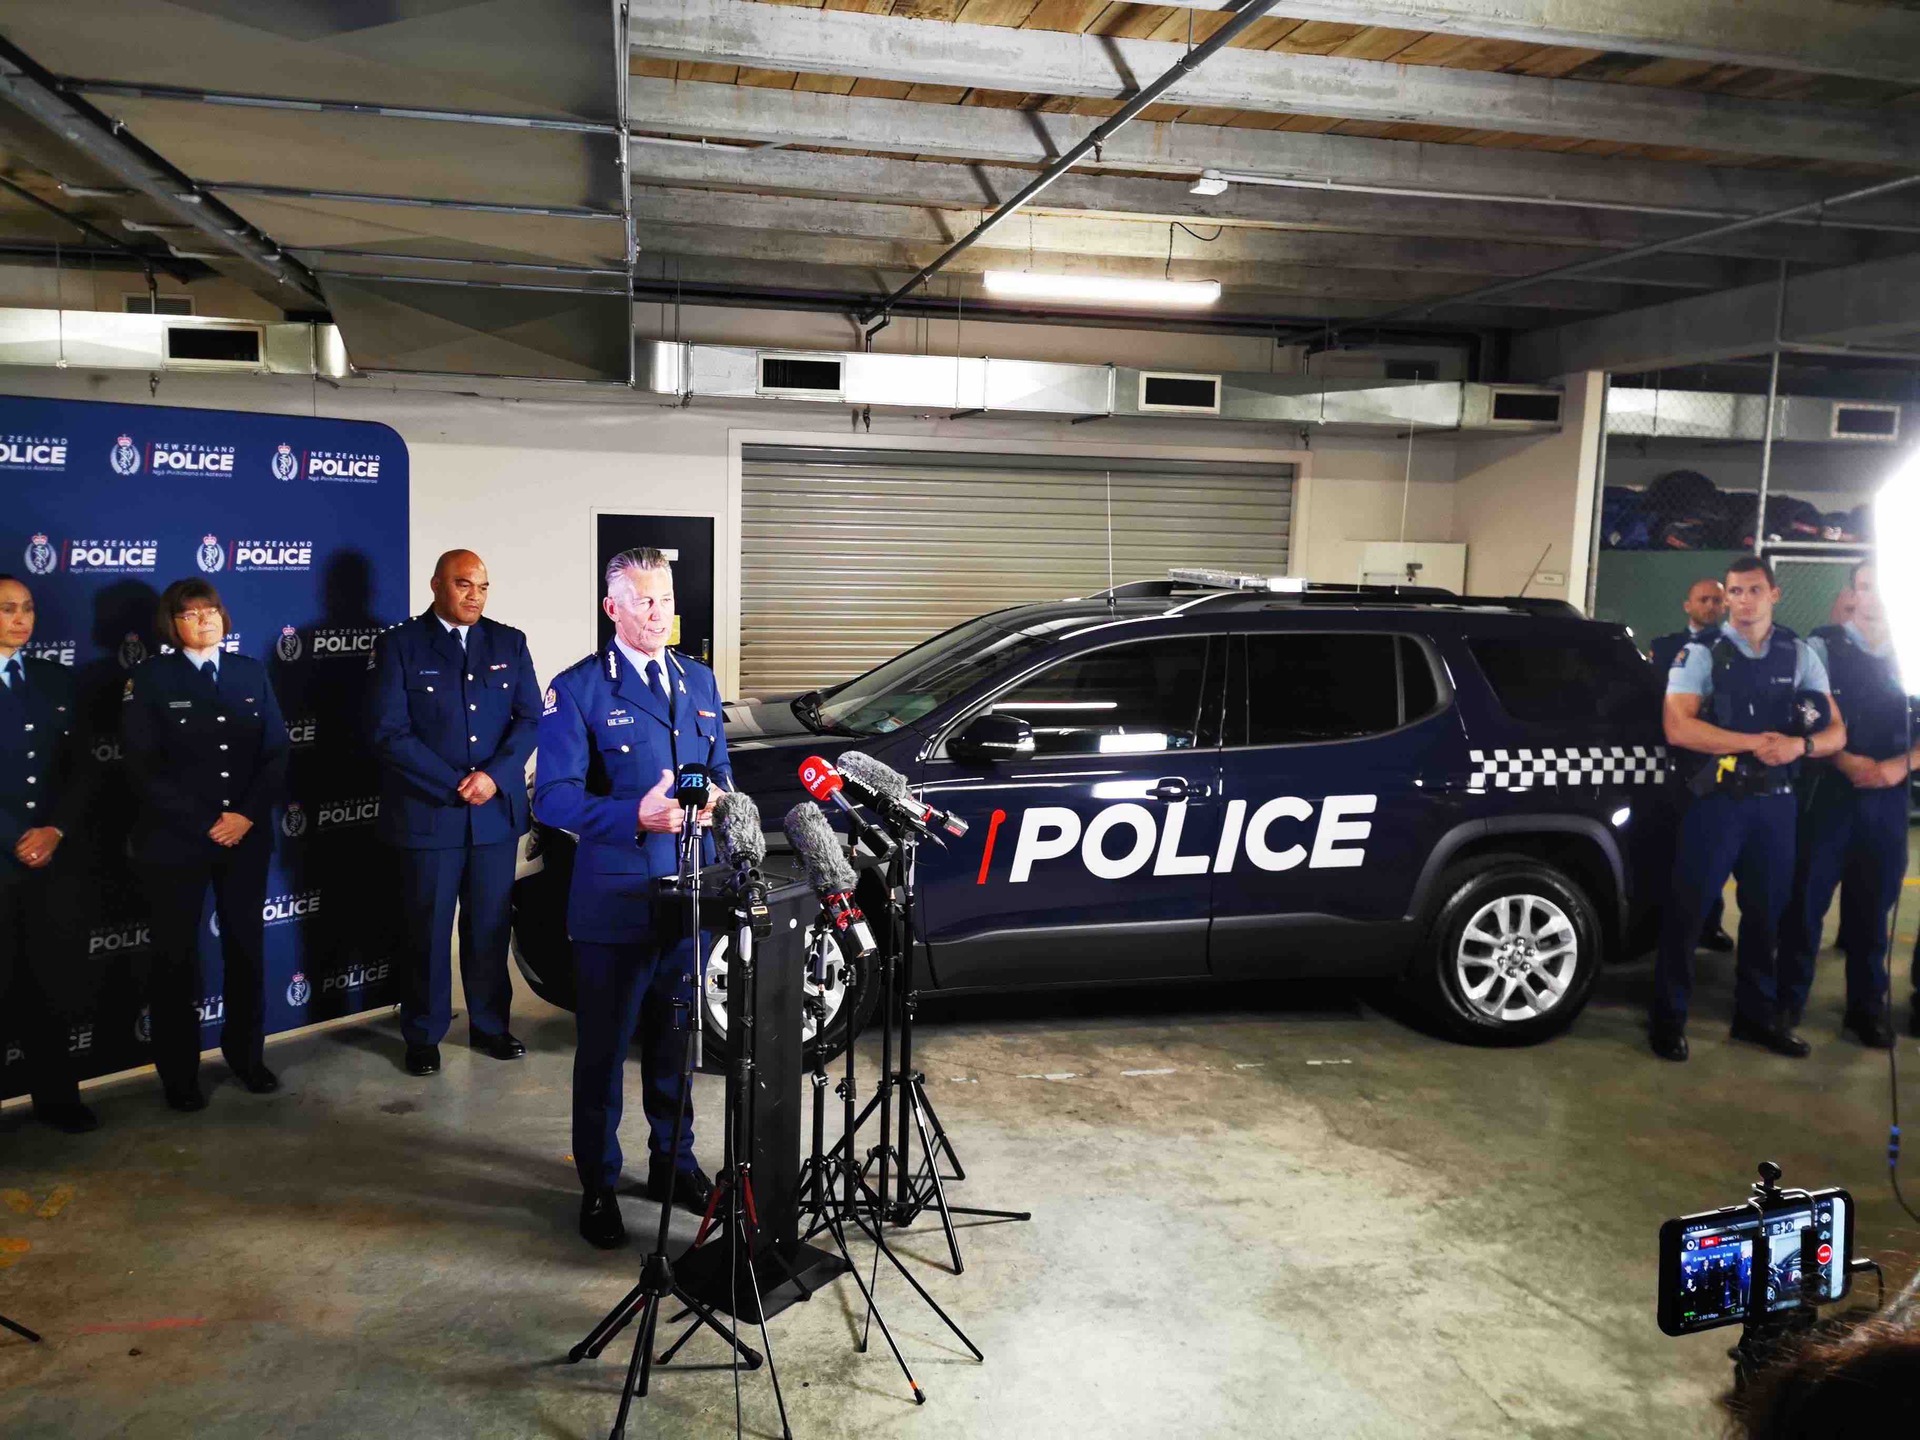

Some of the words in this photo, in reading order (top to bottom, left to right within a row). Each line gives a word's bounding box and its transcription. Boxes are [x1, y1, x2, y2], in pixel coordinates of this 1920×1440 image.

[8, 434, 68, 446] ZEALAND
[184, 444, 235, 453] ZEALAND
[0, 443, 67, 465] OLICE
[153, 451, 235, 471] POLICE
[336, 452, 381, 461] ZEALAND
[309, 458, 380, 477] POLICE
[70, 548, 157, 566] POLICE
[236, 548, 311, 565] POLICE
[26, 640, 76, 649] EALAND
[680, 773, 704, 788] ZB
[1009, 795, 1378, 883] POLICE
[262, 896, 321, 921] OLICE
[89, 929, 151, 954] POLIC
[321, 963, 390, 993] POLICE
